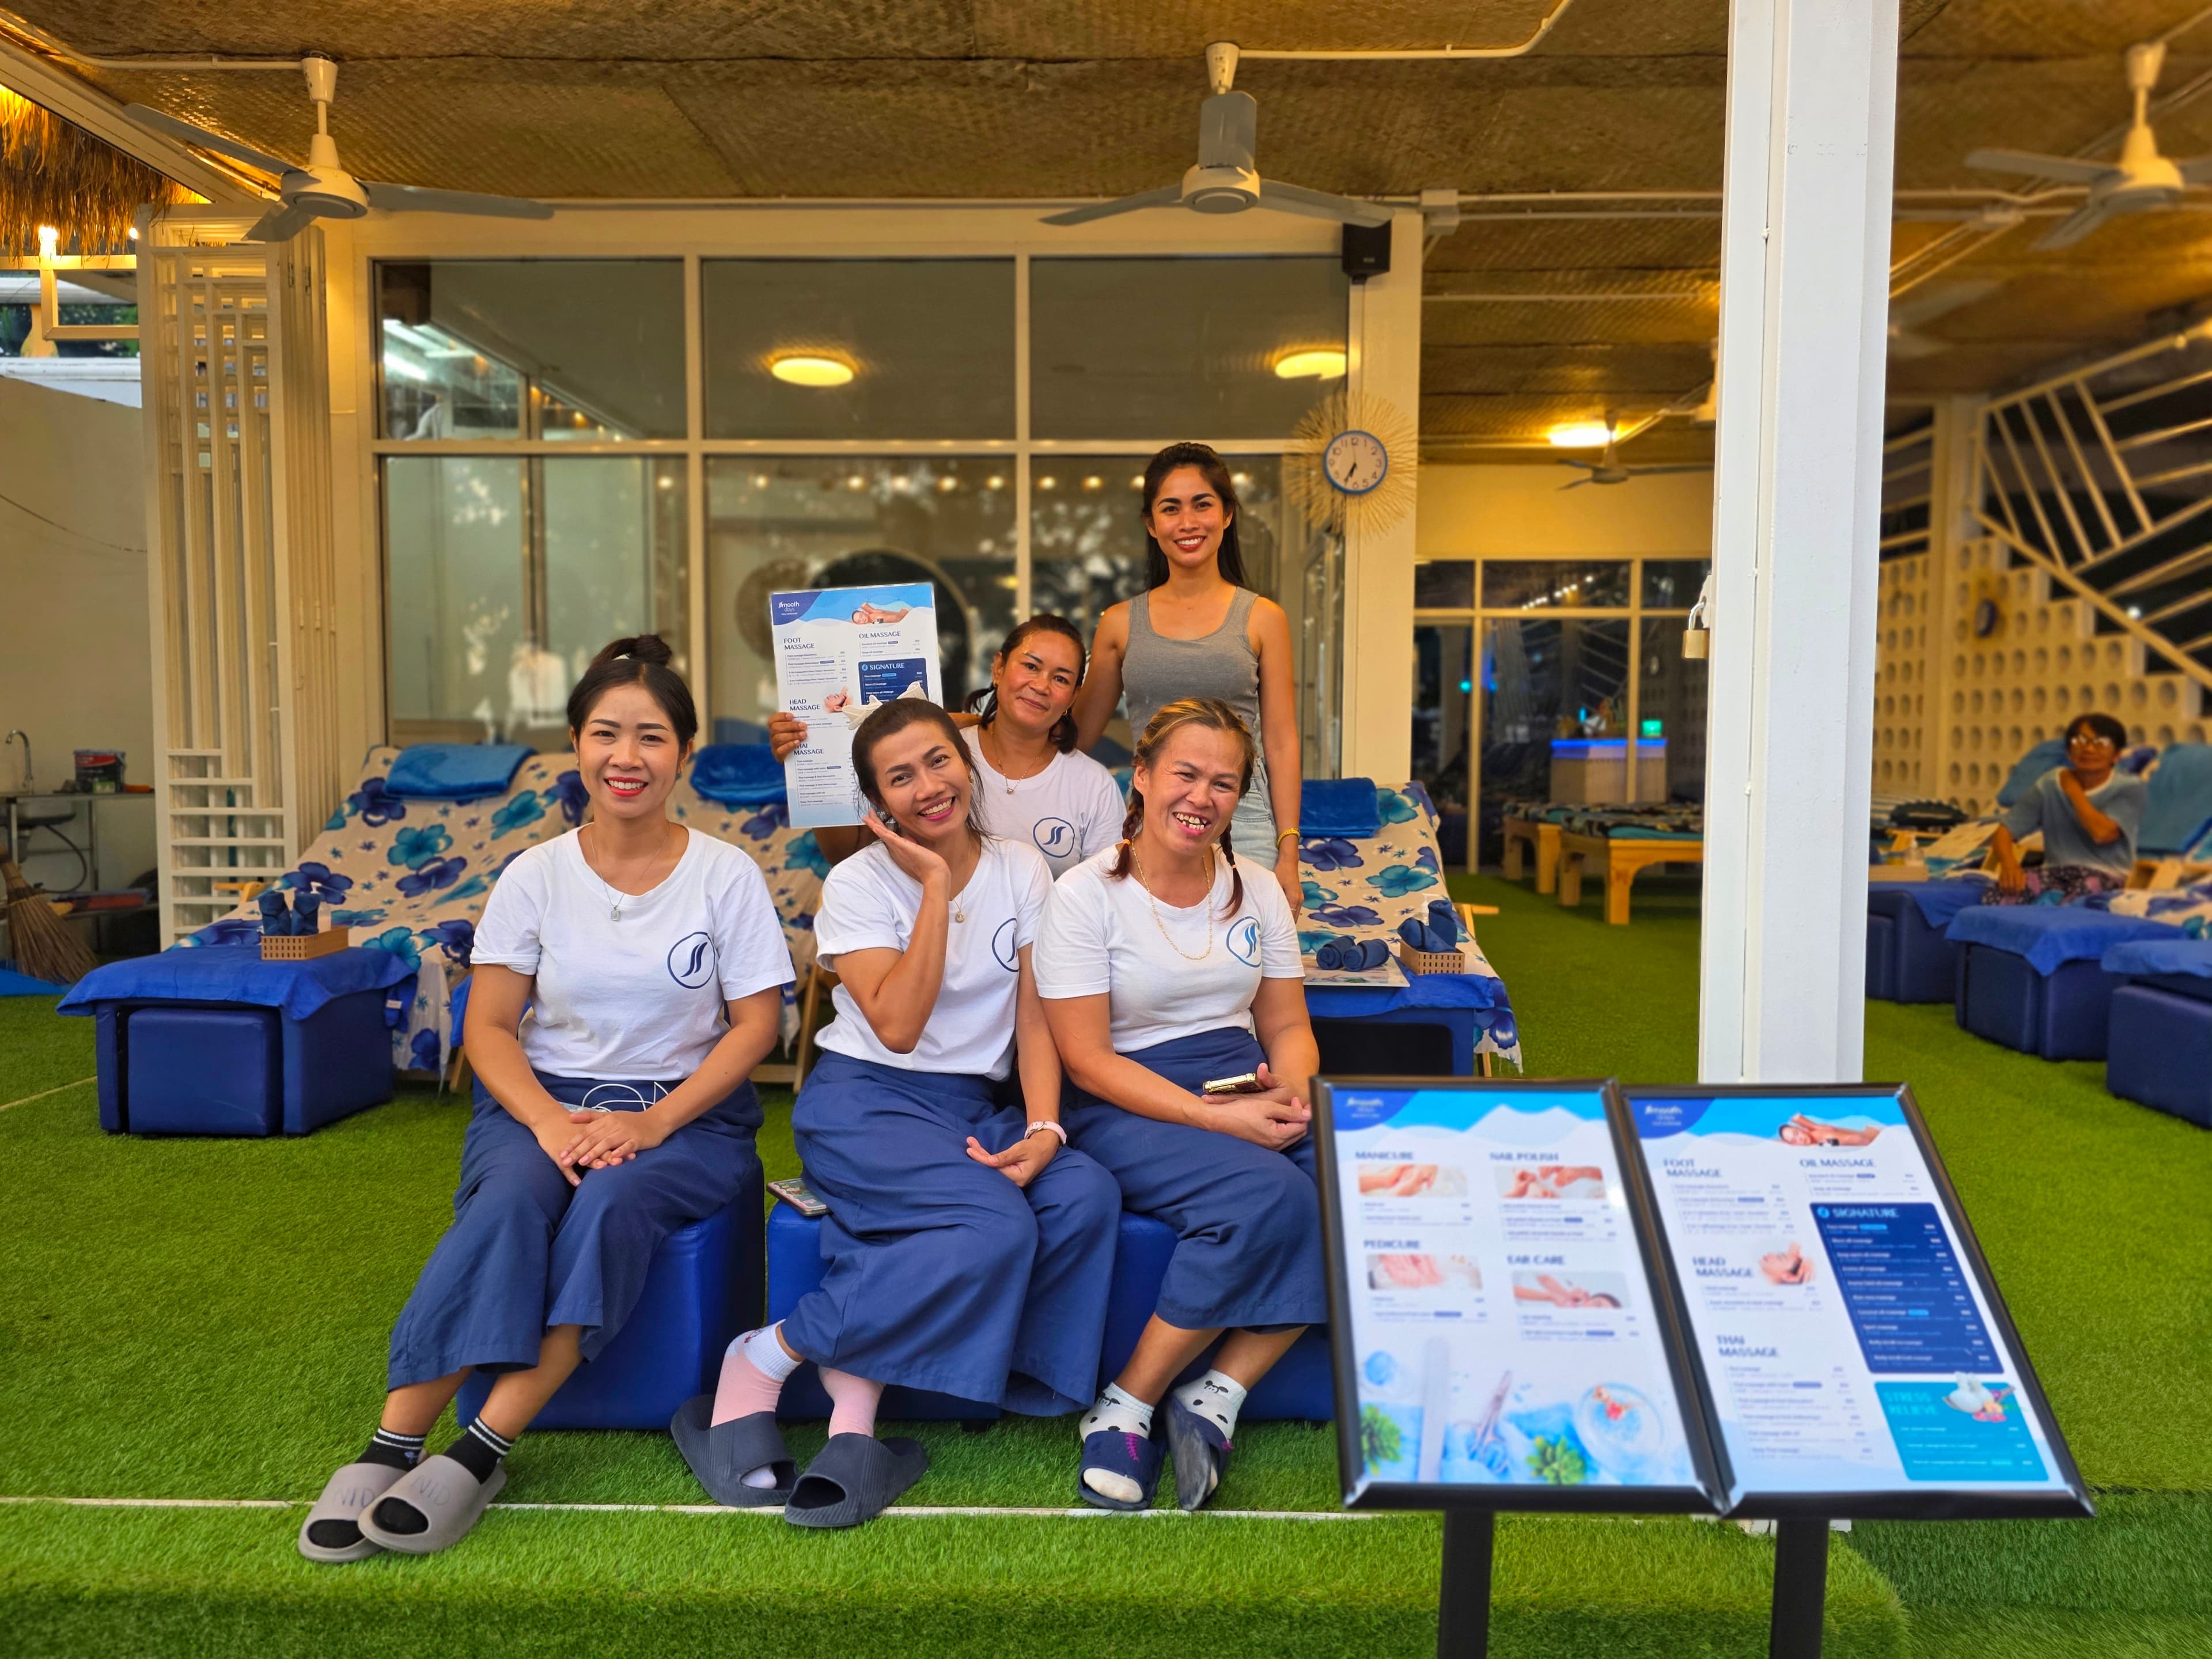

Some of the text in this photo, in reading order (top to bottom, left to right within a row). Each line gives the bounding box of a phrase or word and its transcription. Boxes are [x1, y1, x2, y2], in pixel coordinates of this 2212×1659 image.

[1355, 1151, 1413, 1160] MANICURE
[1663, 1158, 1695, 1168] FOOT
[1820, 1158, 1876, 1168] MASSAGE
[1666, 1168, 1722, 1177] MASSAGE
[1832, 1208, 1899, 1218] SIGNATURE
[1506, 1255, 1565, 1265] EAR CARE
[1692, 1256, 1726, 1266] HEAD
[1696, 1268, 1753, 1278] MASSAGE
[1716, 1335, 1745, 1345] THAI
[1718, 1348, 1779, 1358] MASSAGE
